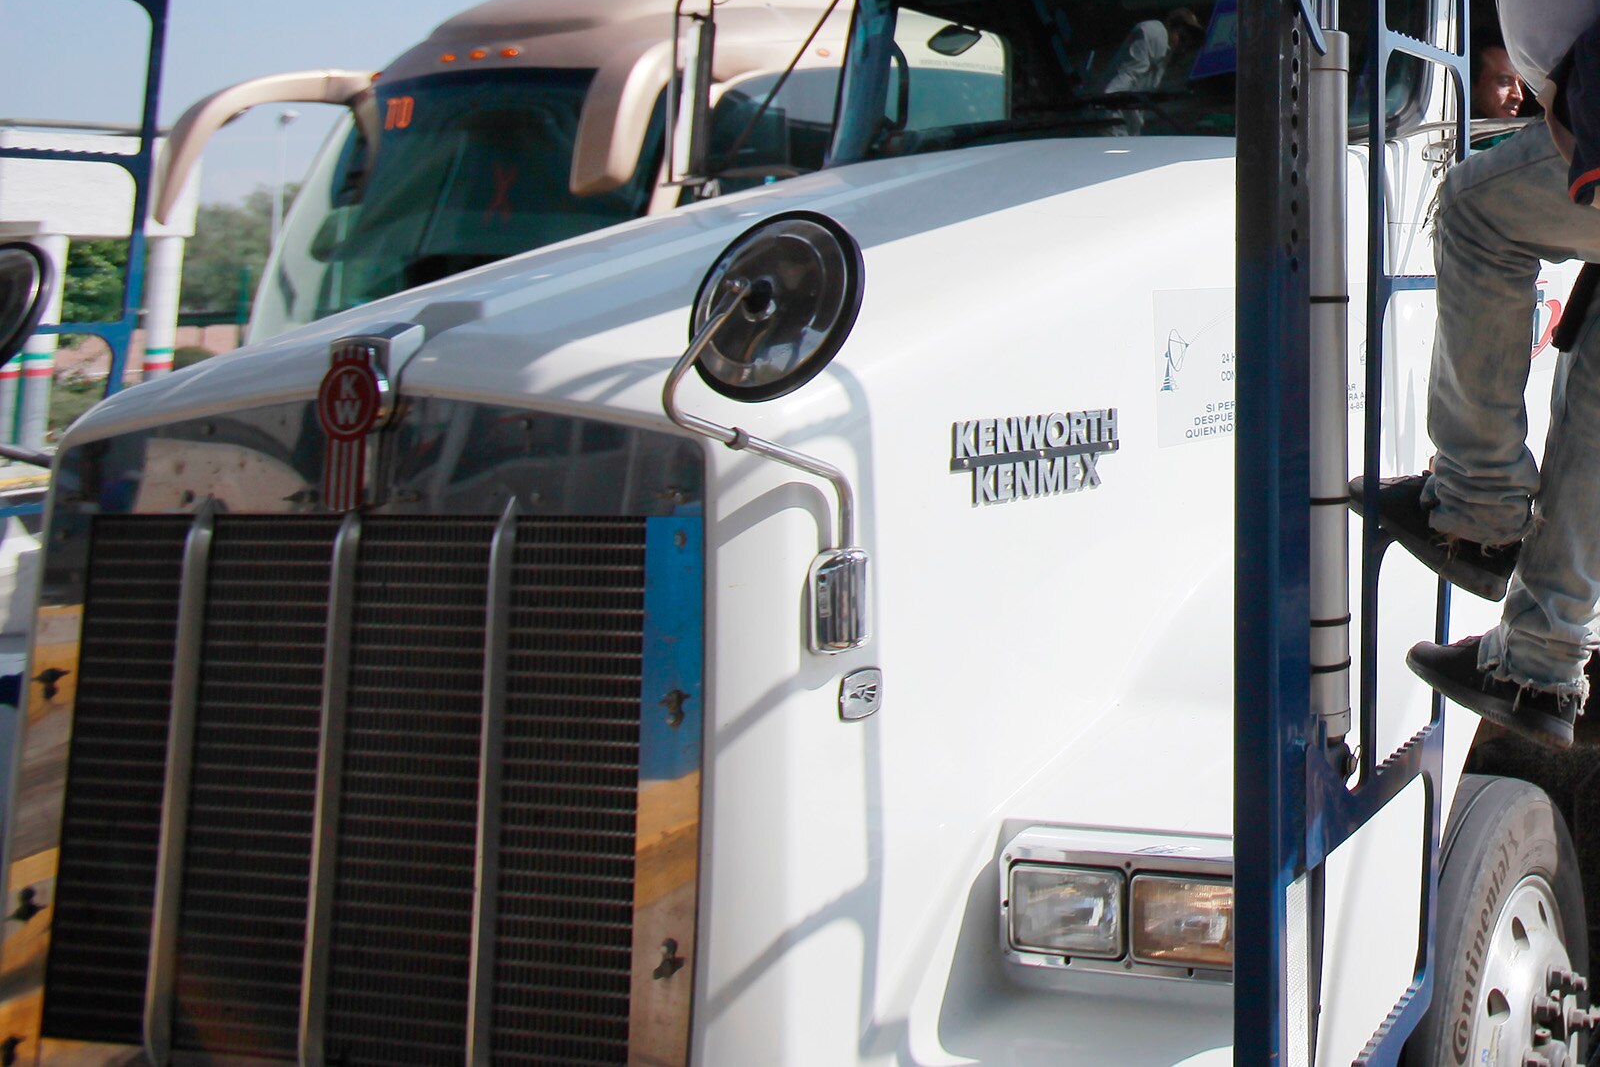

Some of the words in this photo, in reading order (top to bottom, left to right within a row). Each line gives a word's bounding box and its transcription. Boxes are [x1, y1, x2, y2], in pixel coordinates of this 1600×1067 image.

[1206, 403, 1215, 412] SI
[951, 408, 1119, 459] KENWORTH
[1185, 425, 1217, 439] QUIEN
[971, 452, 1102, 507] KENMEX
